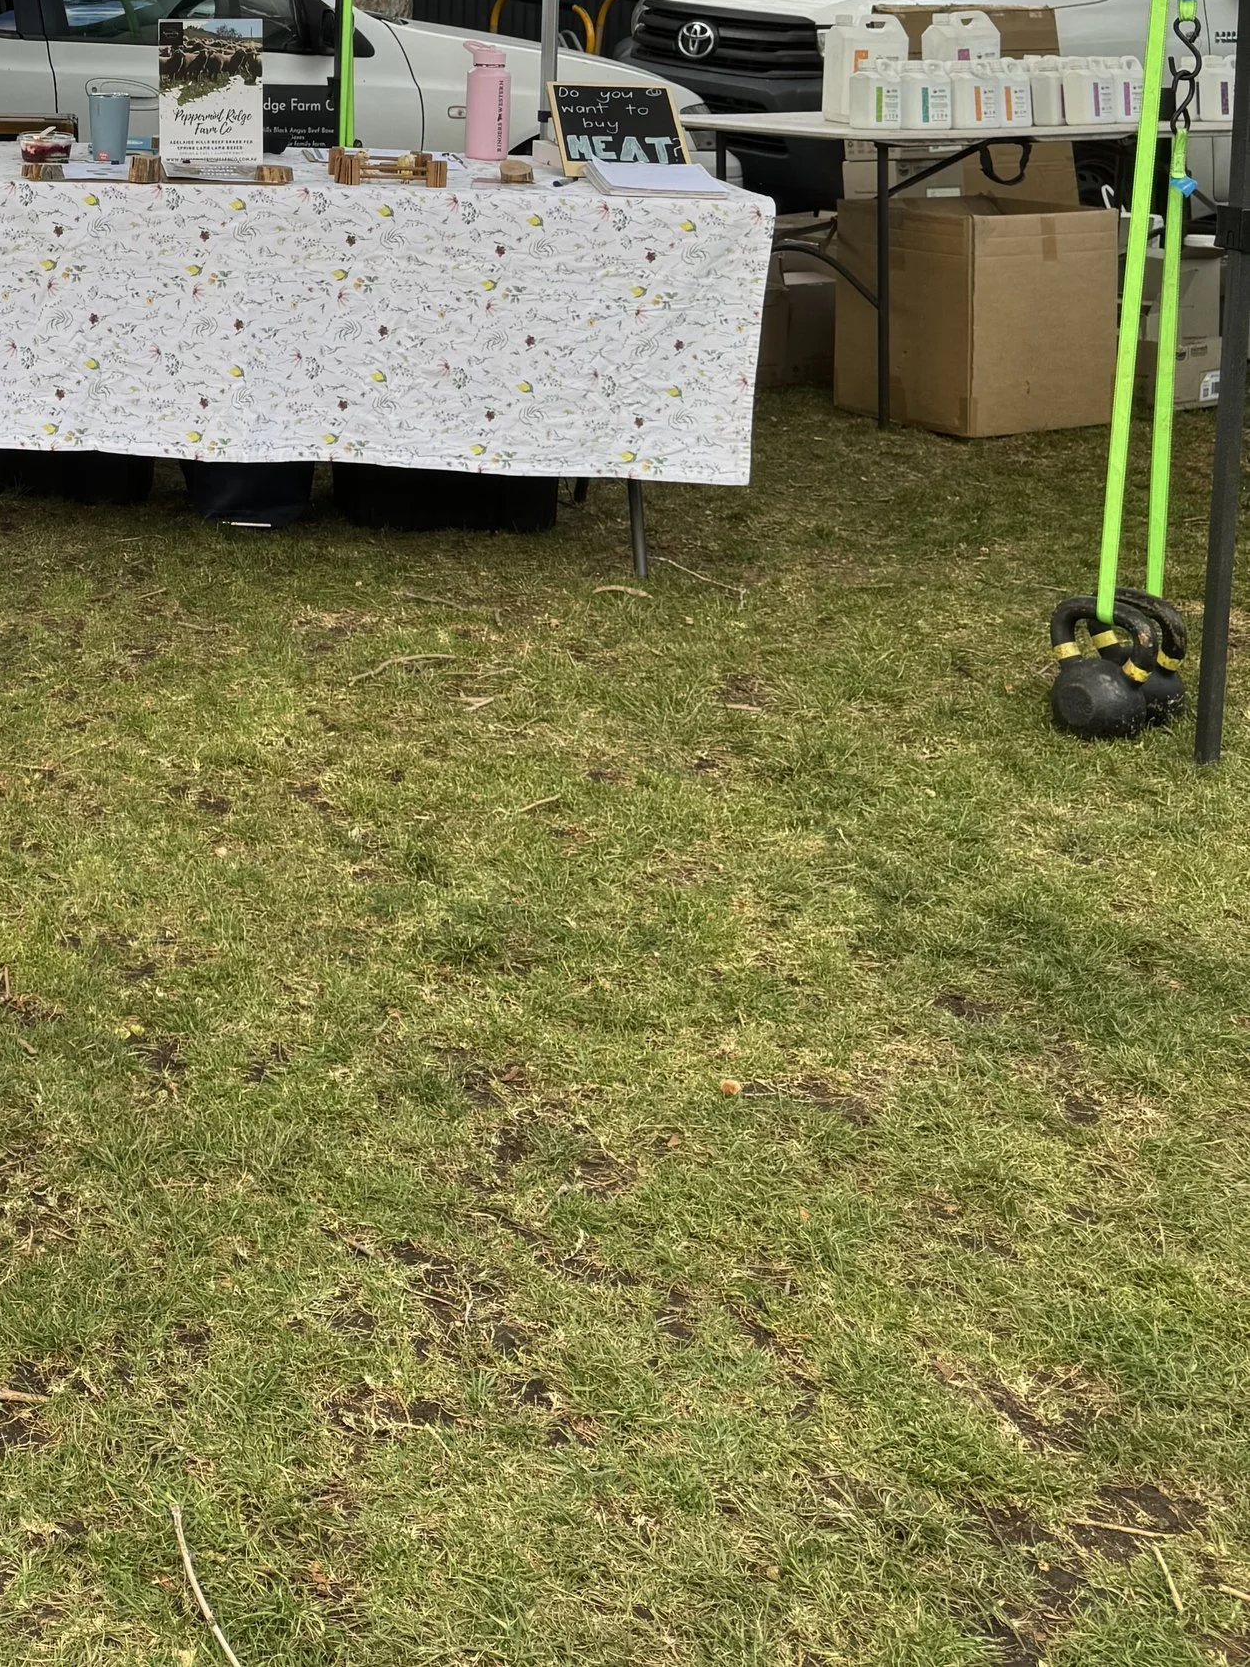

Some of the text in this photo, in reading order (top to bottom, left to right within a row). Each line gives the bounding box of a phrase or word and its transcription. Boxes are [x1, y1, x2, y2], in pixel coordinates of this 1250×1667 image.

[558, 86, 634, 104] Do you
[263, 97, 335, 114] dge Farm C
[561, 103, 649, 116] want to
[173, 108, 252, 125] Peppermint Ridge
[582, 117, 620, 133] buy
[194, 121, 232, 135] Farm Co
[566, 134, 683, 164] MEAT?
